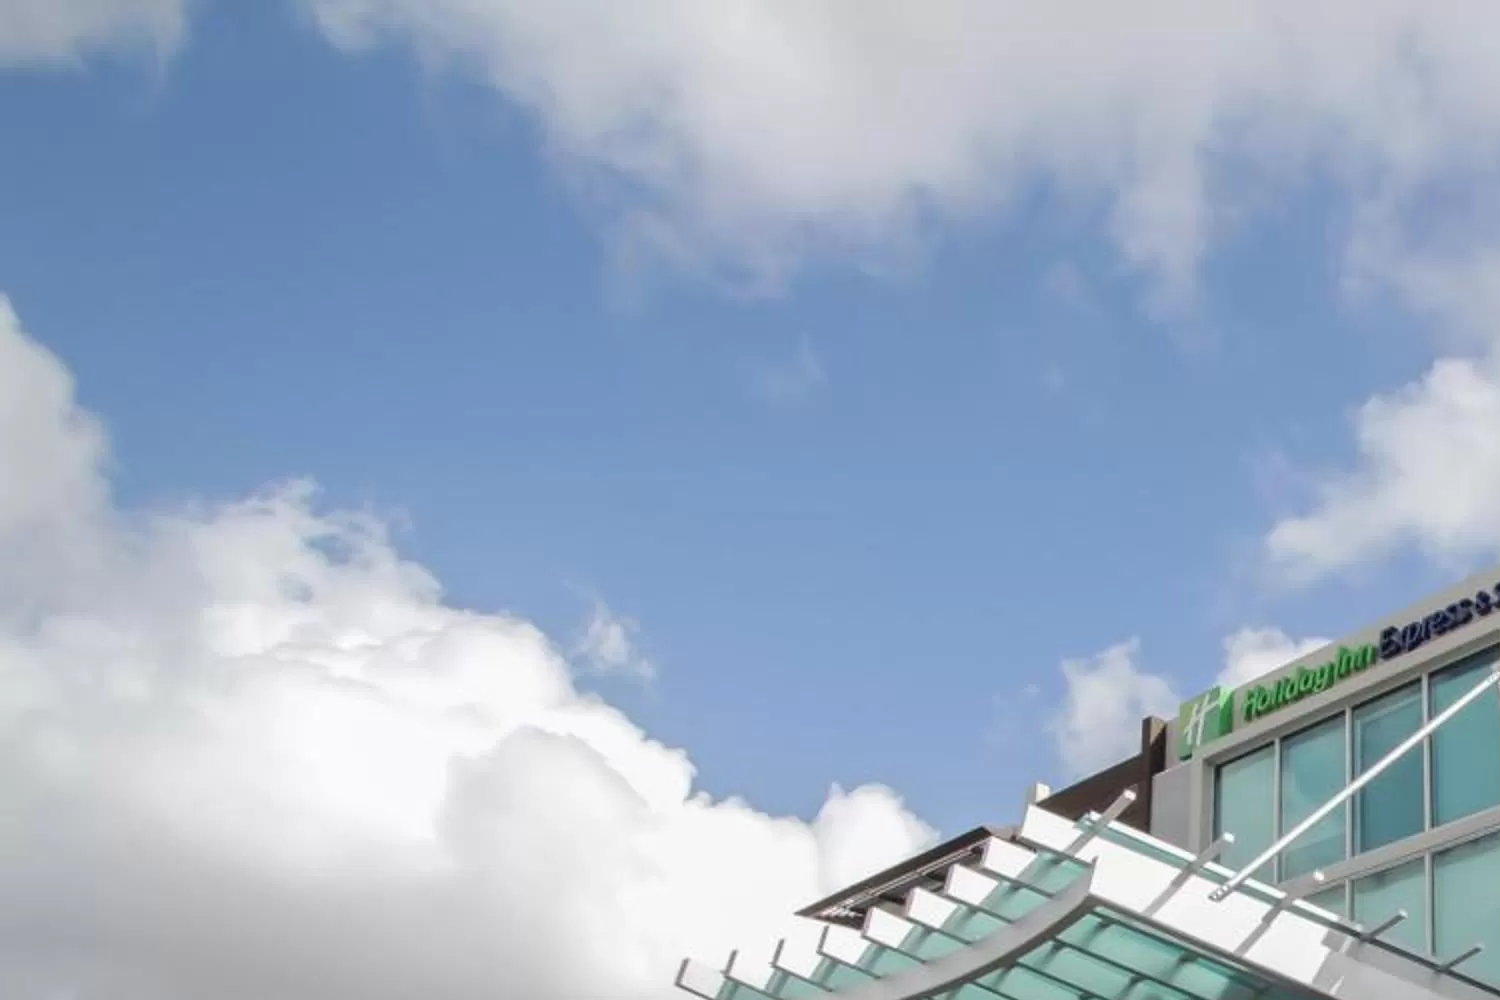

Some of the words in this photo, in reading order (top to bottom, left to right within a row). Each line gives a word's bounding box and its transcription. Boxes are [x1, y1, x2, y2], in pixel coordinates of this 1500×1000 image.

[1244, 663, 1336, 722] Holiday
[1335, 645, 1377, 678] Inn
[1380, 599, 1474, 660] Express
[1475, 591, 1492, 616] &
